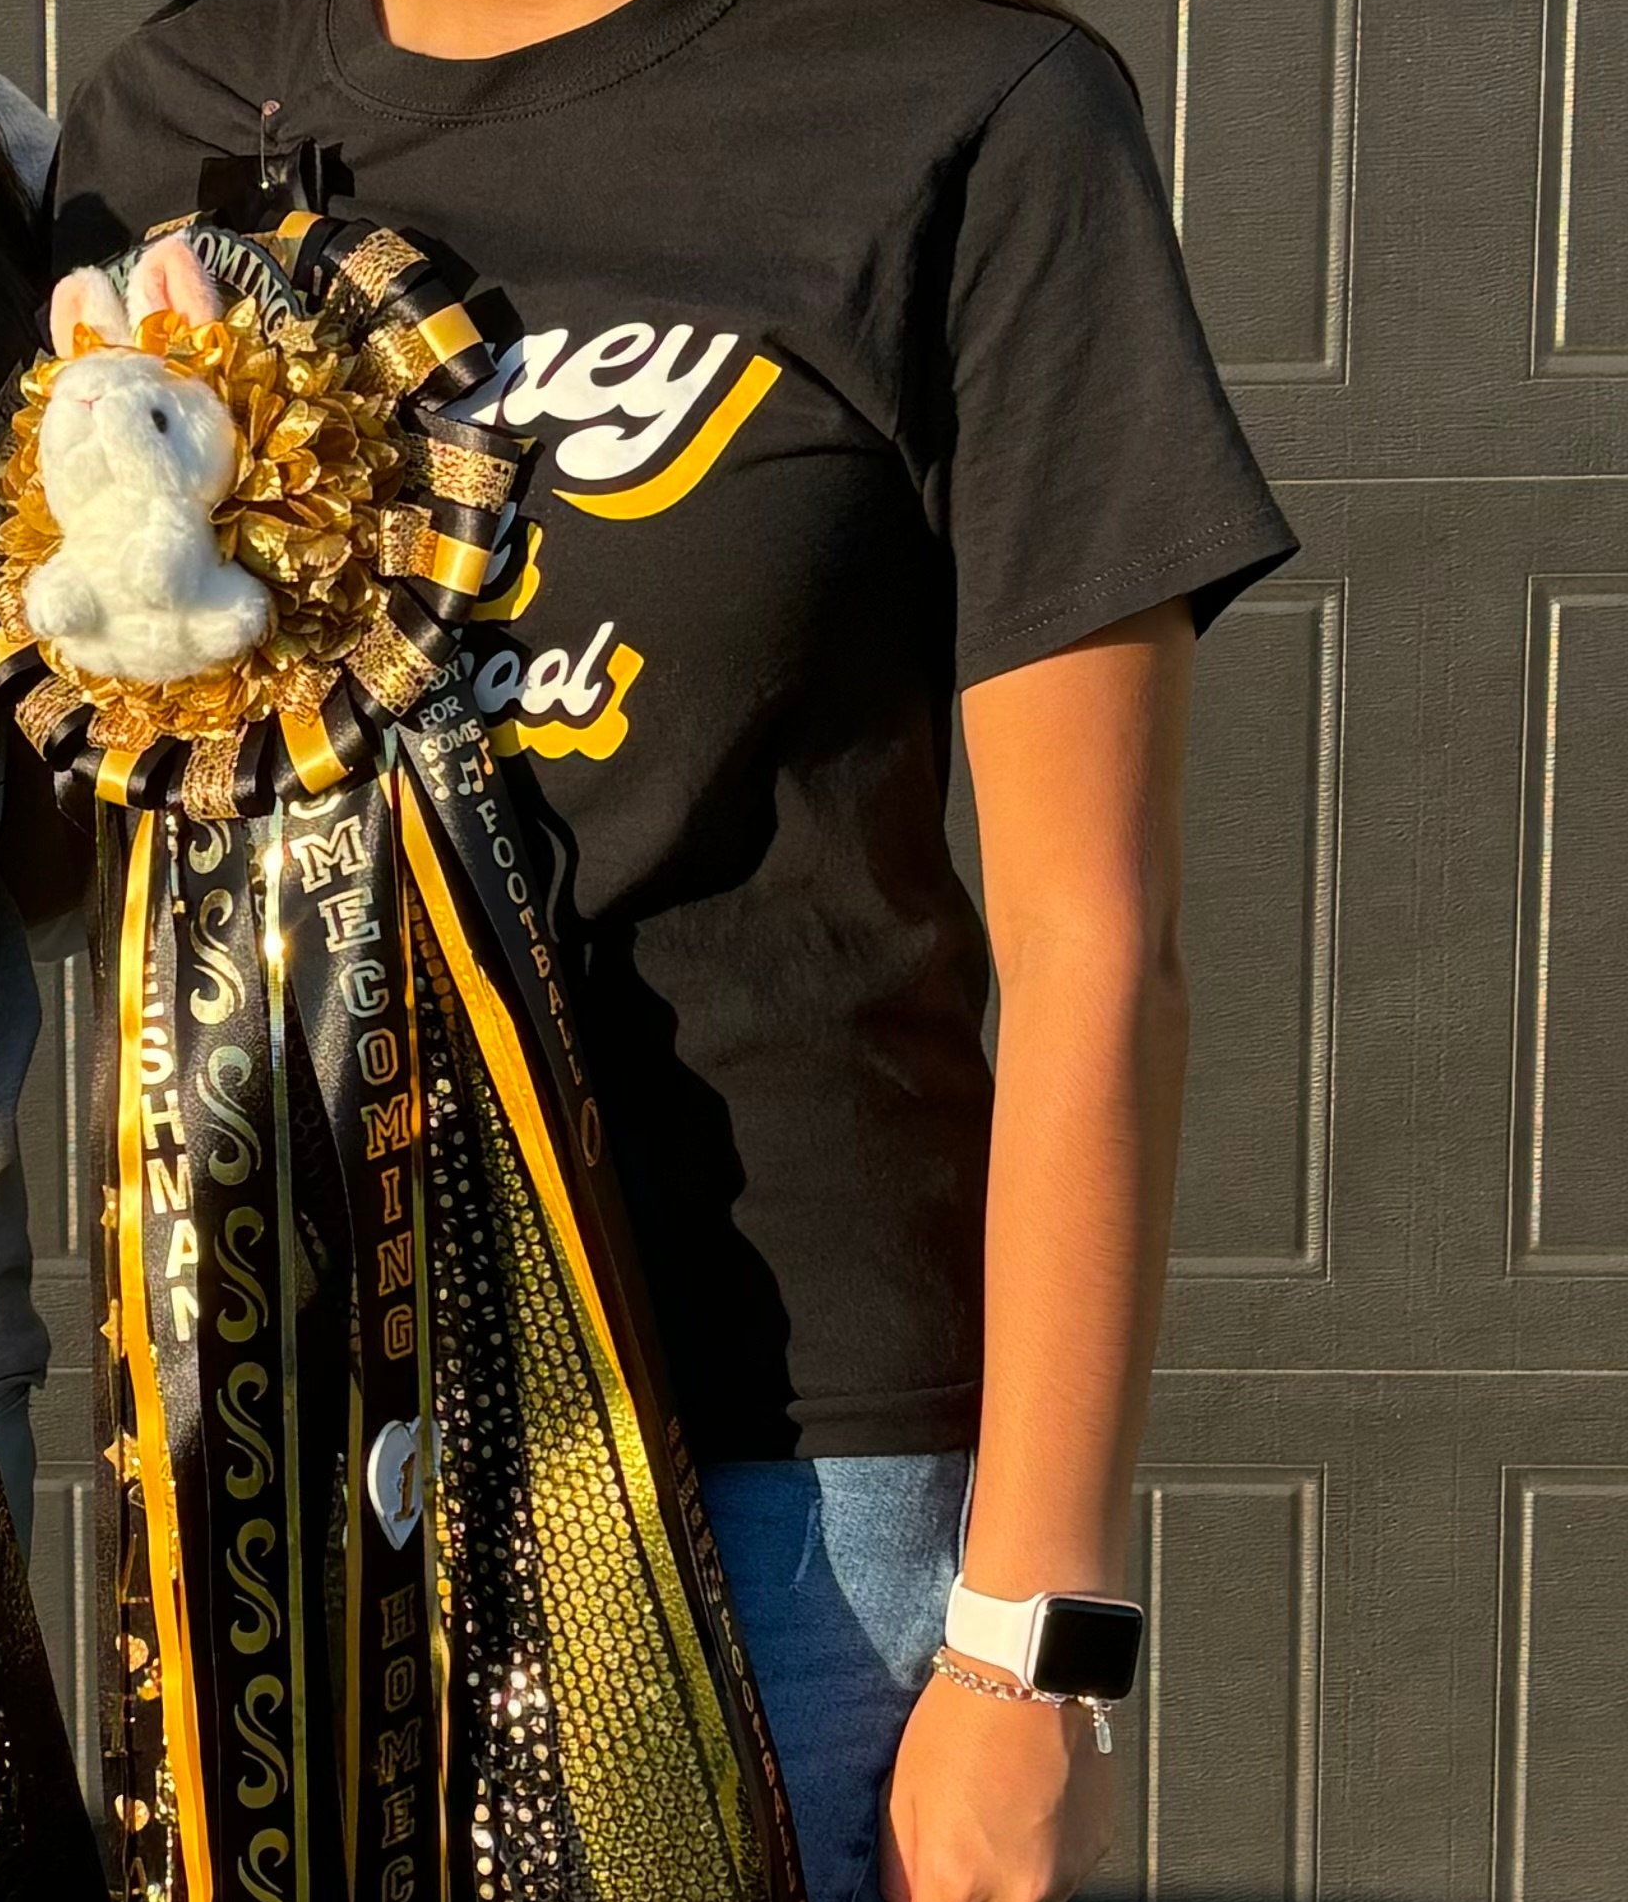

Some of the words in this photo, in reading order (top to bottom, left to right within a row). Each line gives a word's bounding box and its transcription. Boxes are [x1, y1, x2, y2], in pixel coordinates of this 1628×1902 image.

[438, 321, 740, 481] ney
[416, 694, 464, 730] FOR
[462, 621, 614, 716] ool
[419, 717, 483, 762] SOME
[475, 797, 583, 1088] FOOTBALL
[288, 793, 414, 1362] MECOMING
